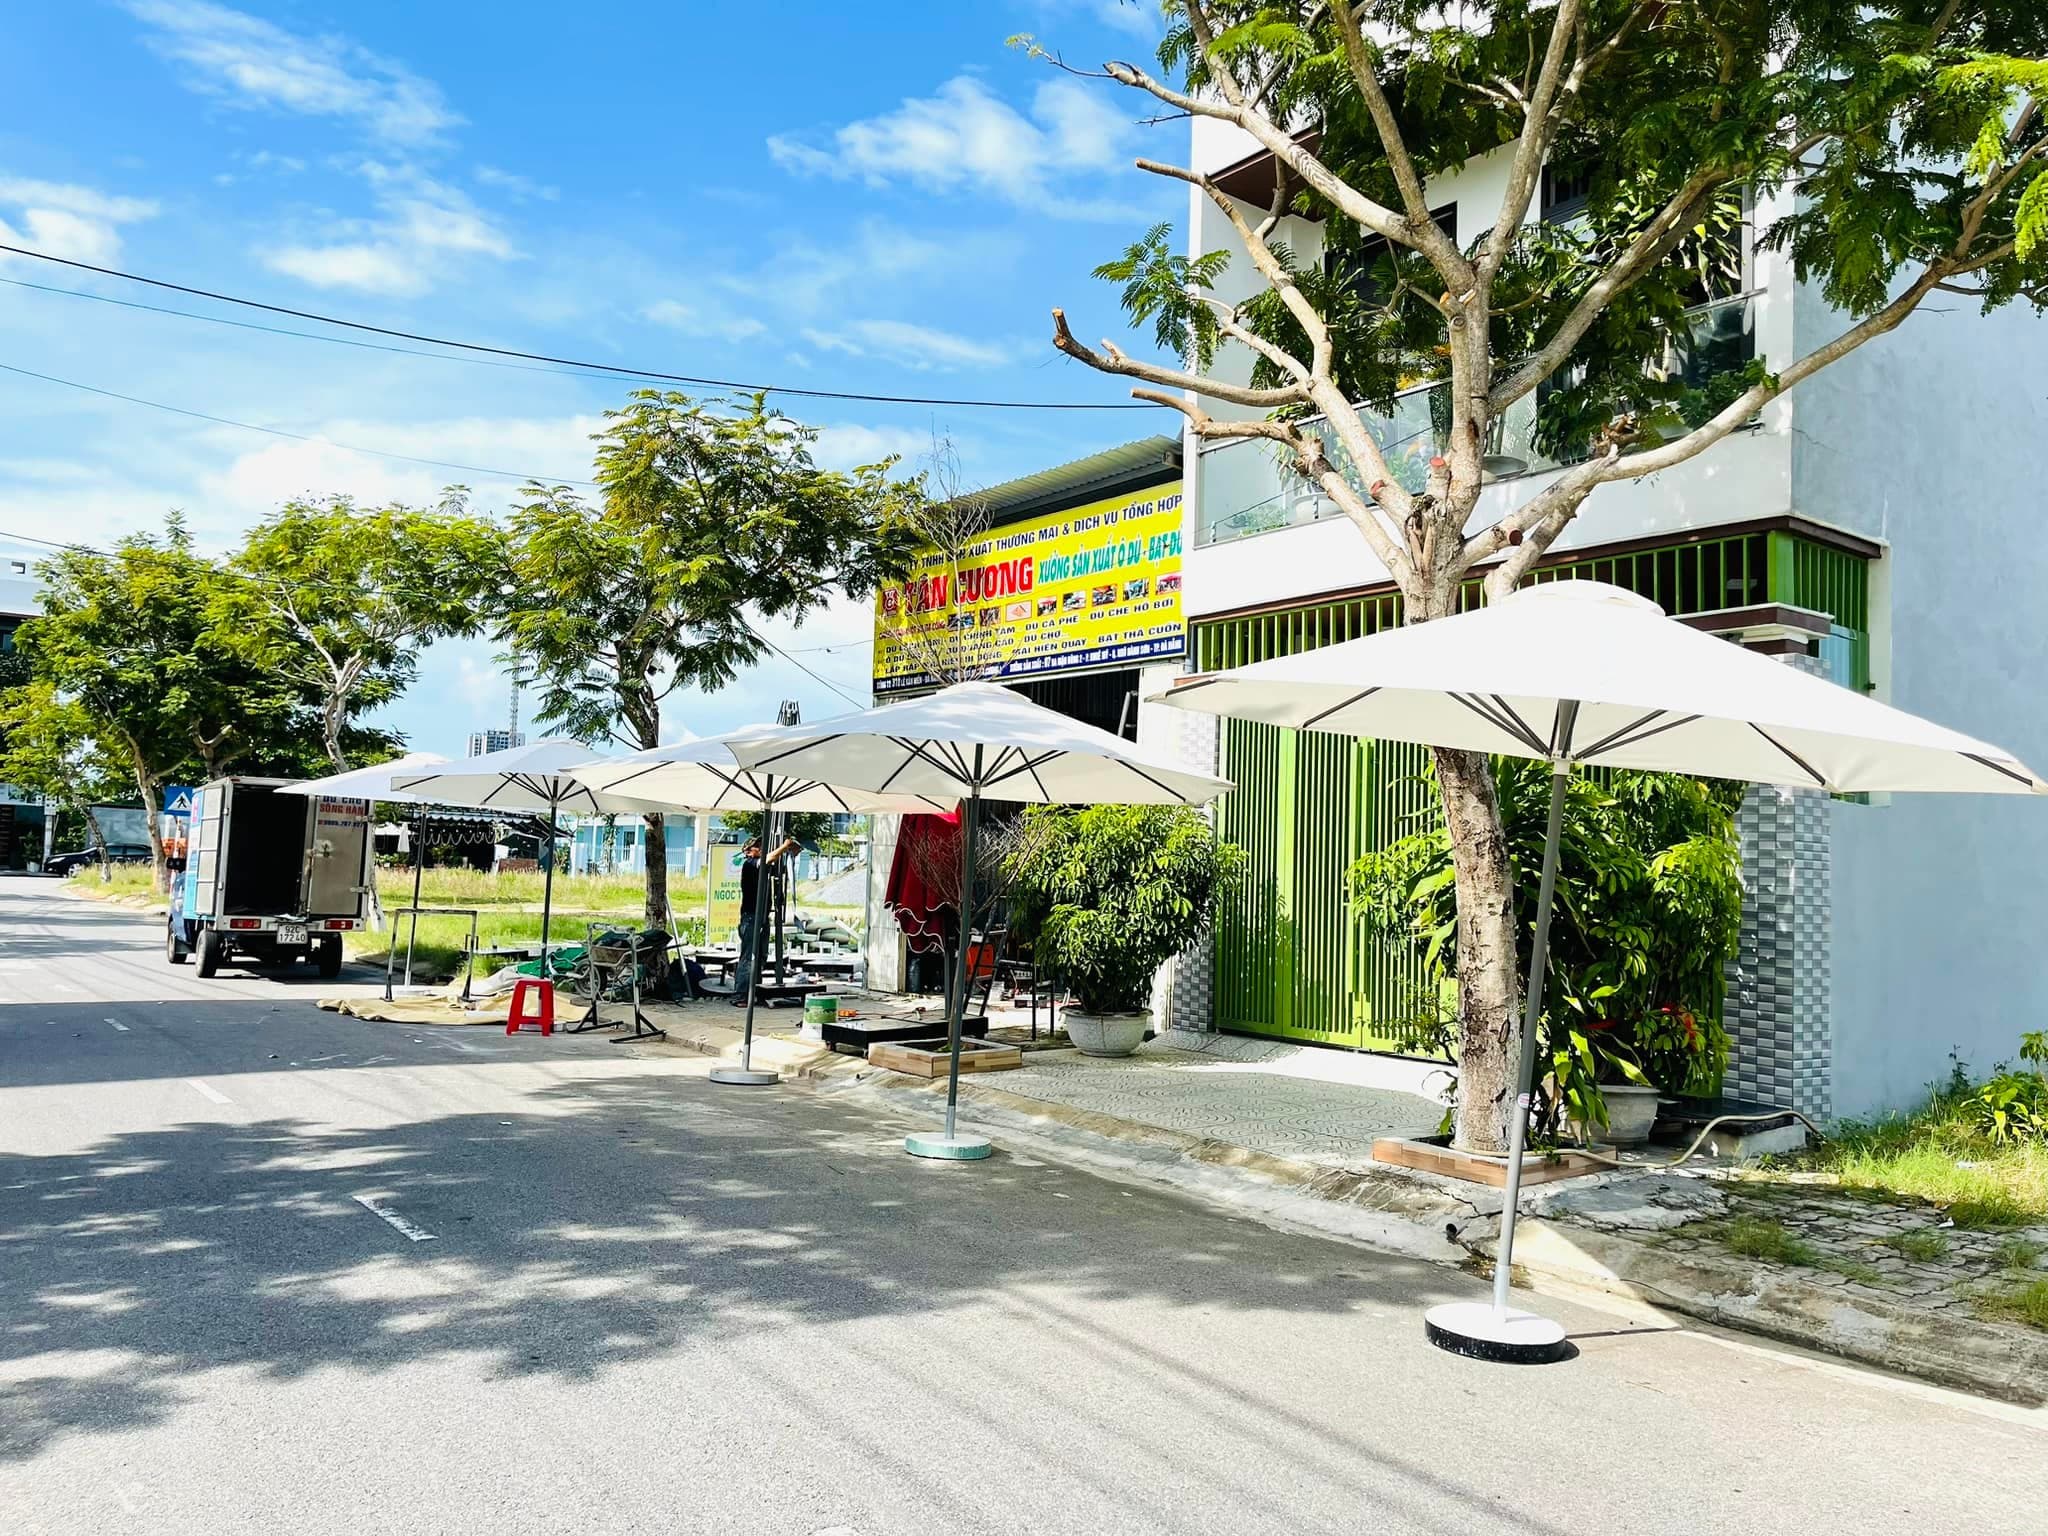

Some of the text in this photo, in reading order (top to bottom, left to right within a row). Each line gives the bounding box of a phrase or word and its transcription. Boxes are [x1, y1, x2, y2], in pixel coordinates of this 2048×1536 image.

[922, 552, 945, 568] TNHH
[1062, 522, 1071, 536] &
[1103, 510, 1118, 527] VỤ
[1122, 500, 1153, 520] TỔNG
[1157, 494, 1183, 514] HỢP
[1071, 543, 1091, 577] SẢN
[1091, 534, 1117, 572] XUẤT
[1108, 606, 1129, 617] CHE
